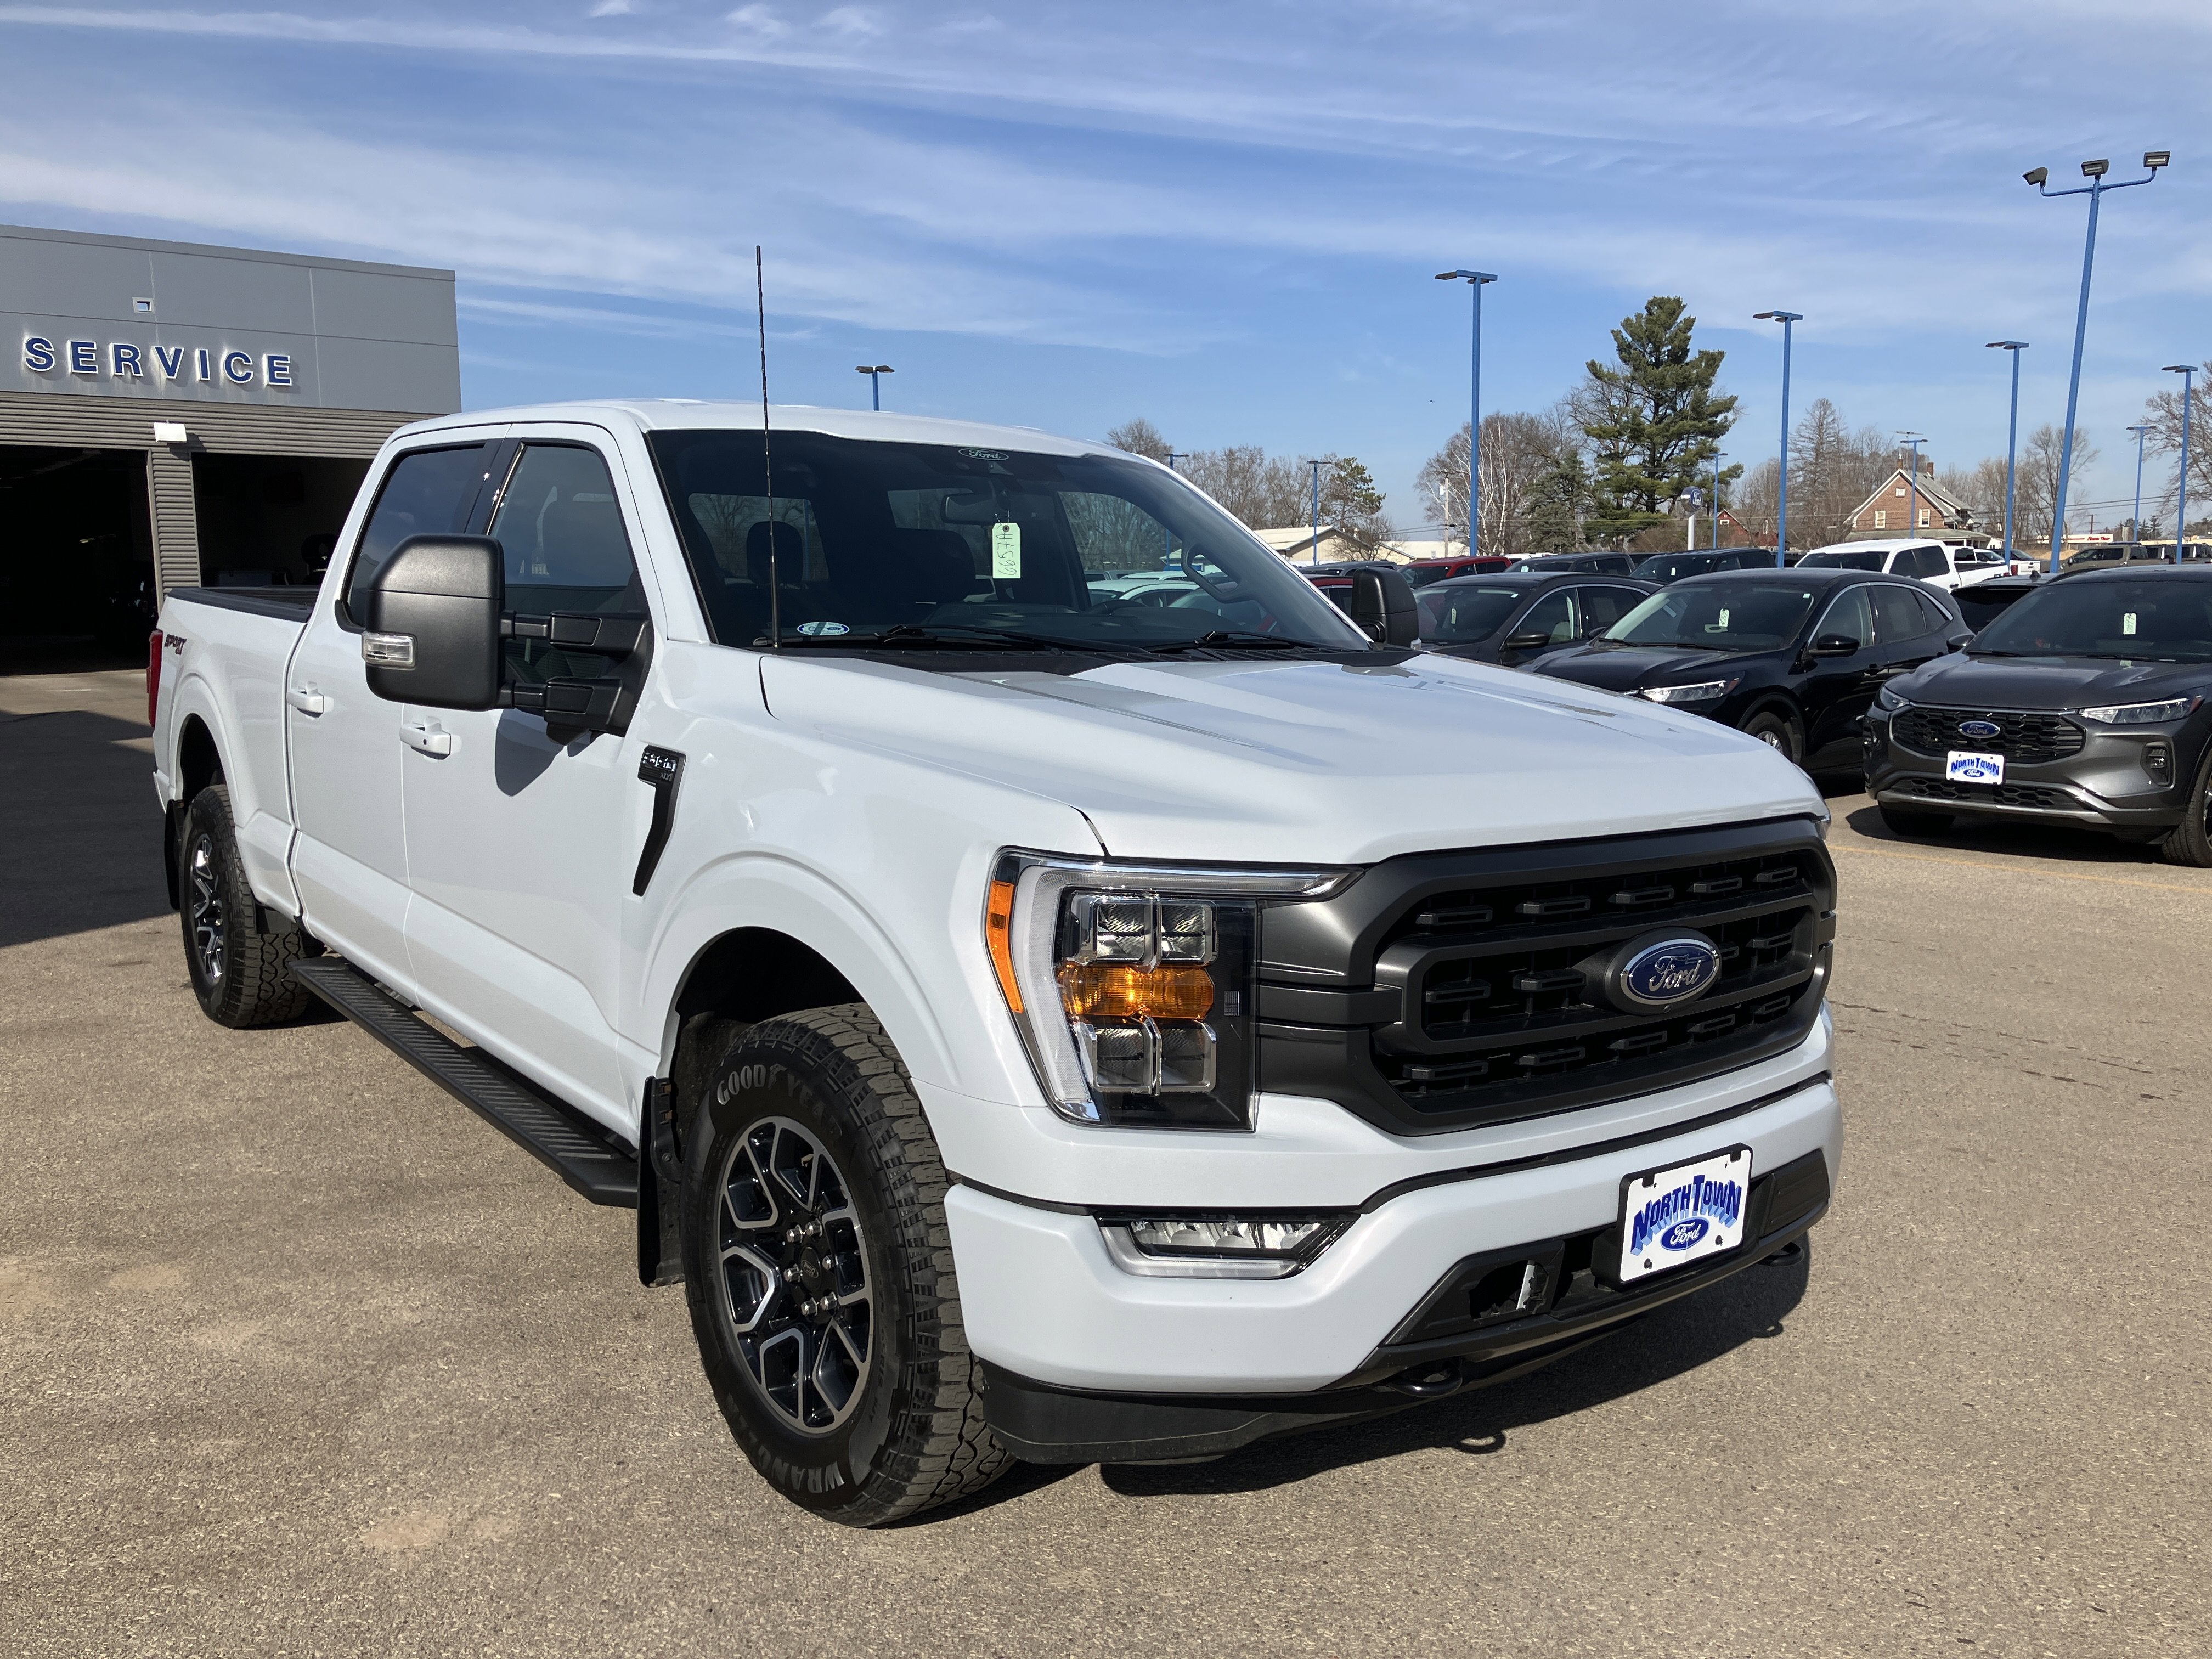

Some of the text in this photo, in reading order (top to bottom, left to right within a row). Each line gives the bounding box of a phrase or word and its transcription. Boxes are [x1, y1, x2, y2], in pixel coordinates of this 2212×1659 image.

[24, 337, 292, 386] SERVICE
[968, 449, 1001, 459] Ford
[1692, 492, 1702, 506] Ford
[996, 532, 1017, 575] 6657A
[1967, 724, 1990, 735] Ford
[660, 772, 673, 782] XLT
[1950, 757, 2000, 777] NORTH TOWN
[1649, 953, 1702, 992] Ford
[1630, 1174, 1742, 1256] NORTH TOWN
[1669, 1222, 1701, 1246] Ford
